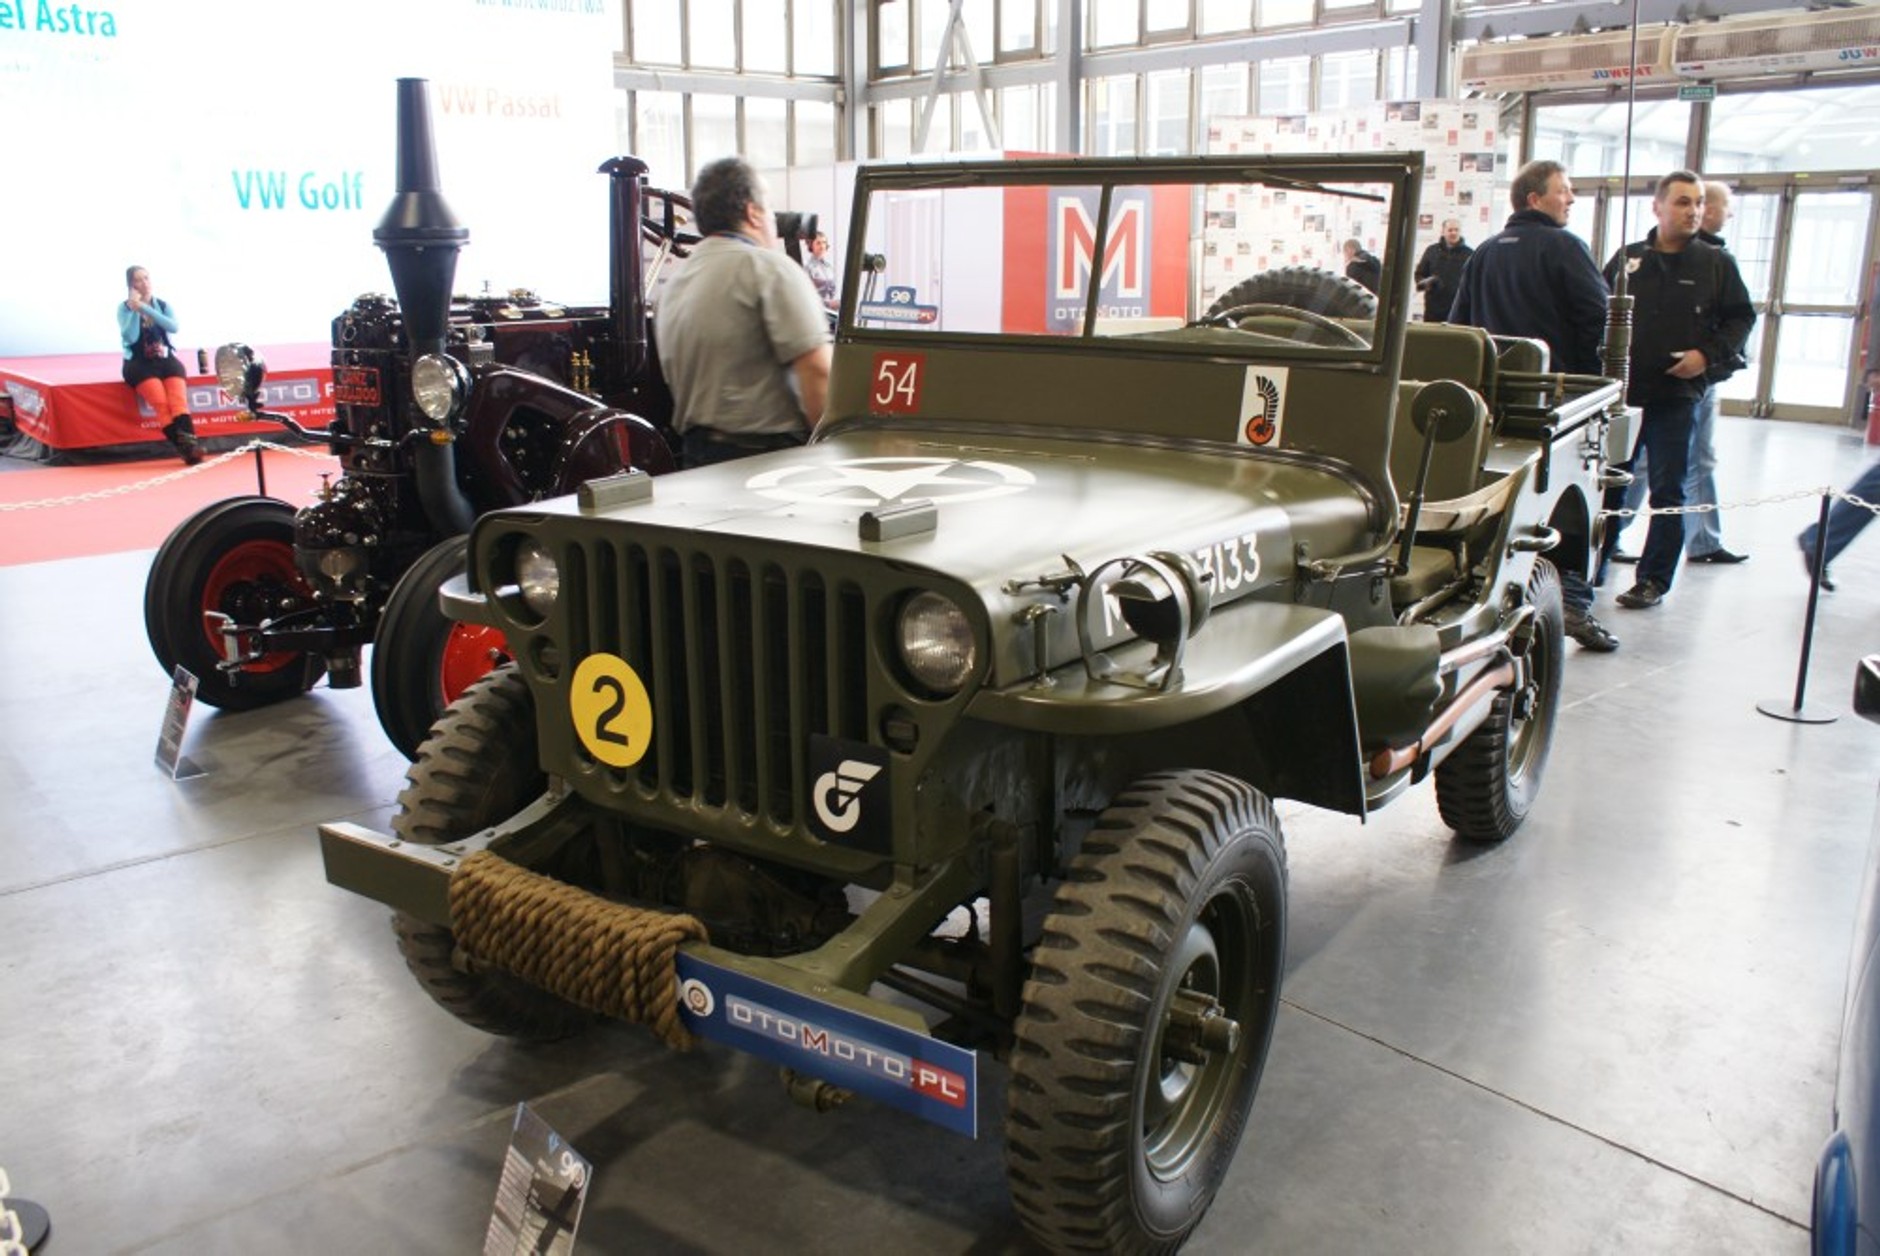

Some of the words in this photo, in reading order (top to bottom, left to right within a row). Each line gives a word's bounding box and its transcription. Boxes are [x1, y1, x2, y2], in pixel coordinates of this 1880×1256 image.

[36, 0, 117, 37] Astra
[438, 84, 477, 114] VW
[486, 87, 562, 119] Passat
[231, 170, 286, 210] VW
[298, 171, 364, 210] Golf
[876, 360, 917, 406] 54
[592, 675, 629, 747] 2
[732, 1002, 958, 1099] OTOMOTO.PL
